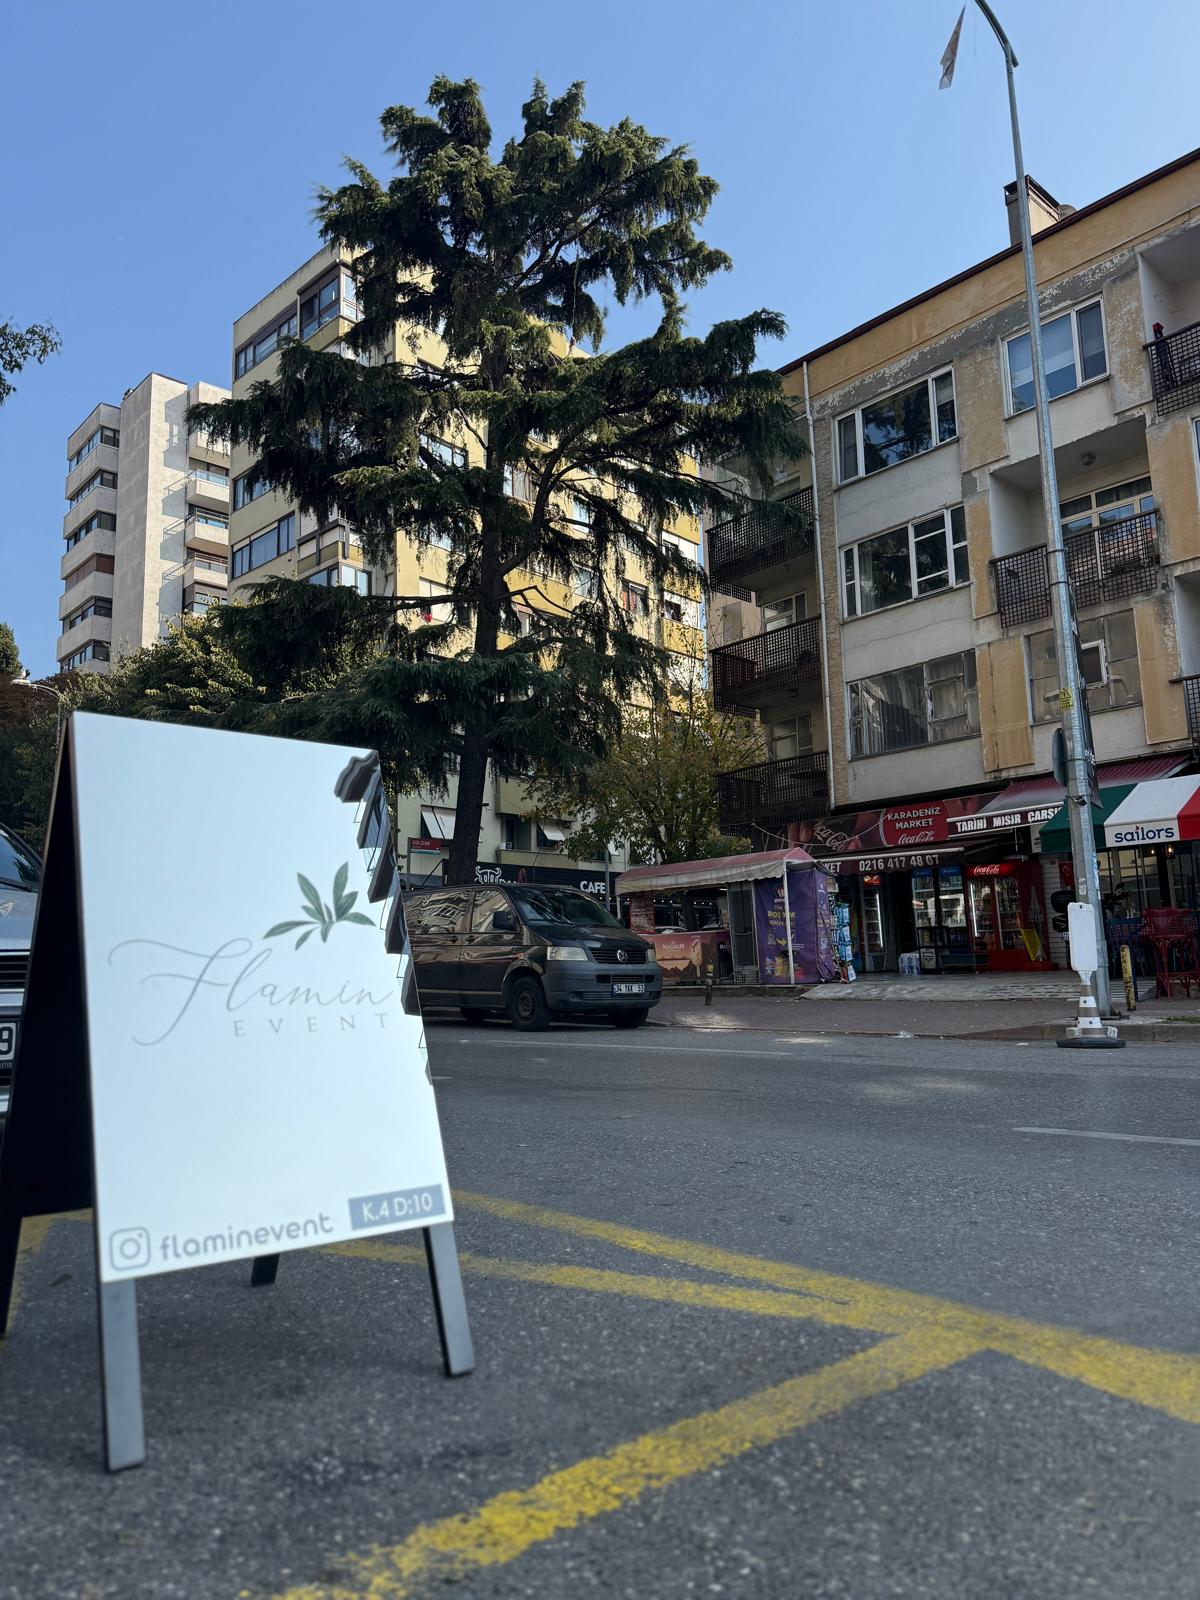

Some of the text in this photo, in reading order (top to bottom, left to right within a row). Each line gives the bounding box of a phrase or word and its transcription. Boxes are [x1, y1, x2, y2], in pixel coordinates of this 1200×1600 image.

[887, 806, 942, 821] KARADENİZ
[993, 813, 1022, 828] MISIR
[895, 818, 934, 830] MARKET
[1114, 825, 1175, 843] sailors
[859, 858, 885, 872] 0216
[887, 856, 906, 870] 417
[910, 855, 924, 867] 48
[926, 854, 940, 866] 07
[580, 880, 607, 894] CAFE
[108, 937, 395, 1047] Flamin
[232, 1012, 389, 1038] EVENT
[160, 1212, 334, 1261] flaminevent
